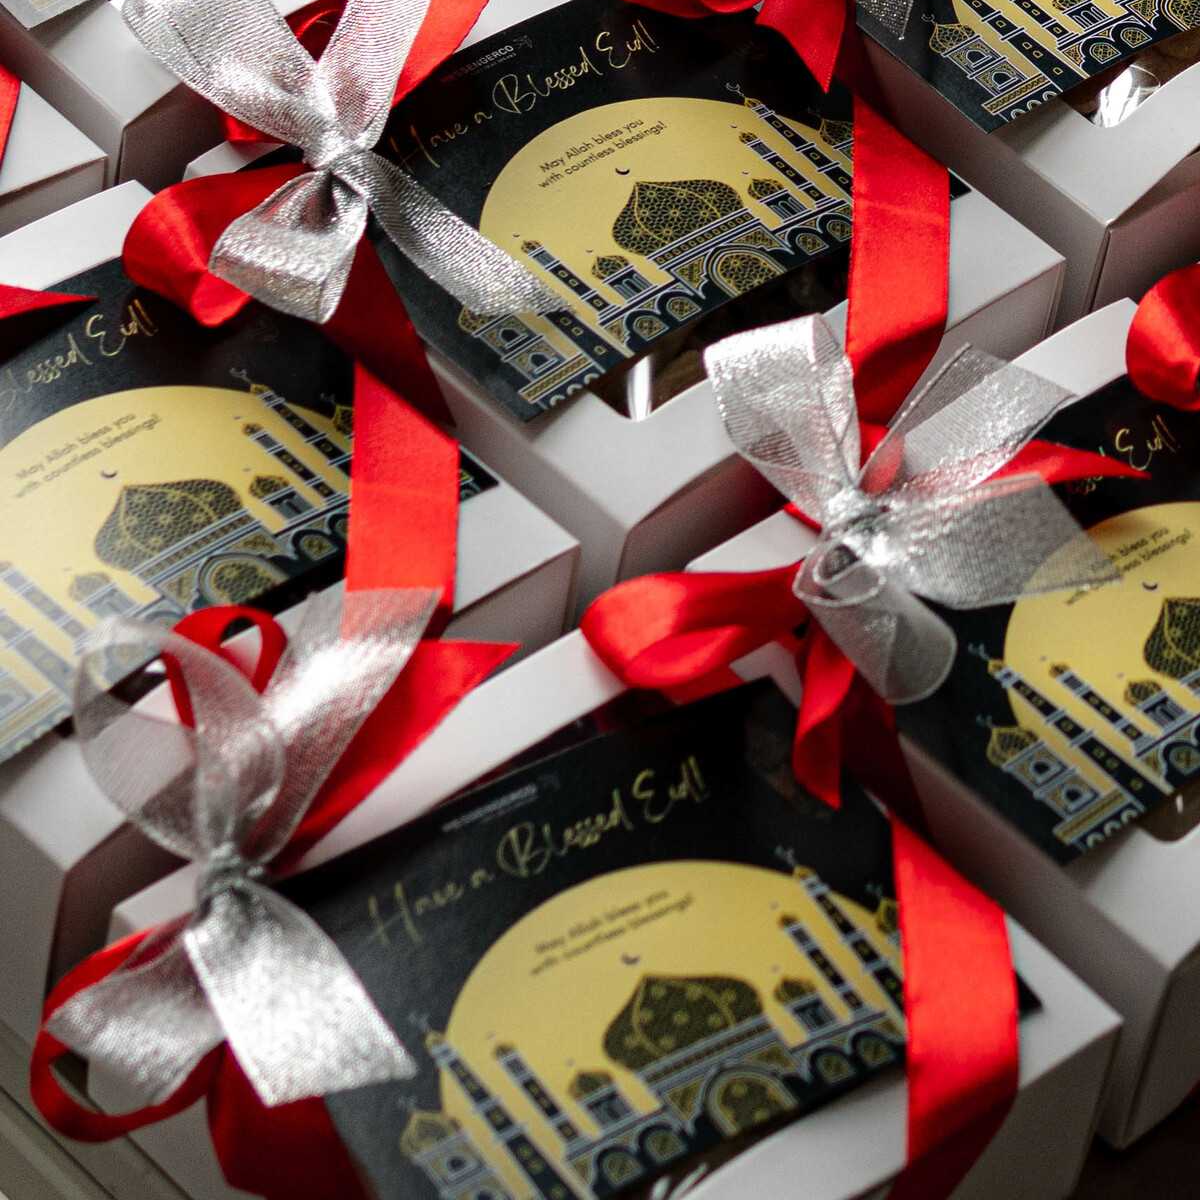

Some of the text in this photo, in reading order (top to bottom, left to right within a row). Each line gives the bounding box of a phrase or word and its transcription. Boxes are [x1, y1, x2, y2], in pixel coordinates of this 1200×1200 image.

[390, 123, 469, 177] Have
[474, 112, 493, 124] a
[492, 46, 604, 114] Blessed
[596, 19, 660, 69] Eid!
[539, 119, 644, 173] May Allah bless you
[539, 120, 667, 188] with countless blessings!
[0, 332, 93, 411] lessed
[366, 880, 463, 943] Have
[496, 785, 635, 878] Blessed
